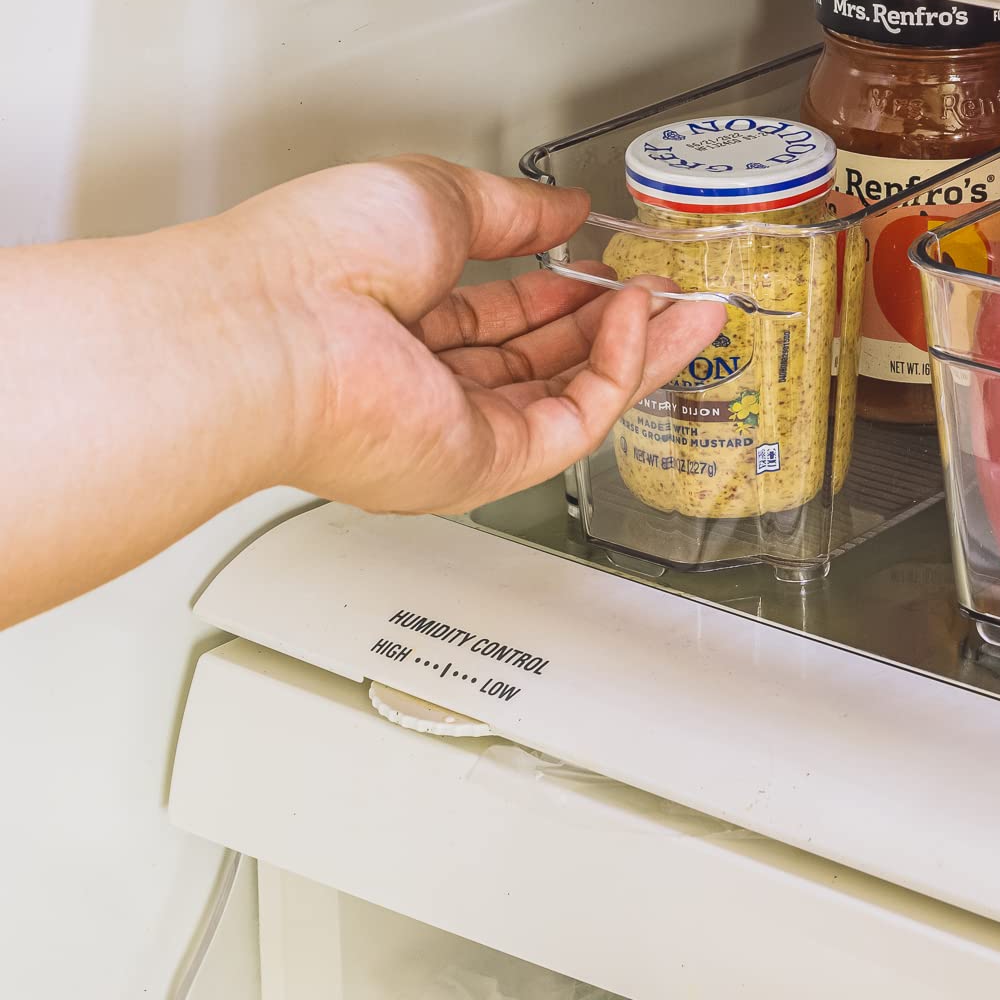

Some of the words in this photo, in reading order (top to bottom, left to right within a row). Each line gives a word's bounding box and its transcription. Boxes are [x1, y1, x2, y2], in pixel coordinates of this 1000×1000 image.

[872, 3, 969, 34] Renfro's
[686, 118, 817, 164] POUPON
[643, 142, 734, 173] GREY
[890, 360, 905, 374] NET
[907, 362, 921, 375] WT.
[922, 363, 930, 376] 16
[682, 406, 720, 416] DIJON
[673, 425, 698, 436] WITH
[690, 438, 753, 447] MUSTARD
[388, 609, 477, 647] HUMIDITY
[470, 638, 550, 675] CONTROL
[370, 638, 413, 662] HIGH
[479, 678, 521, 701] LOW
